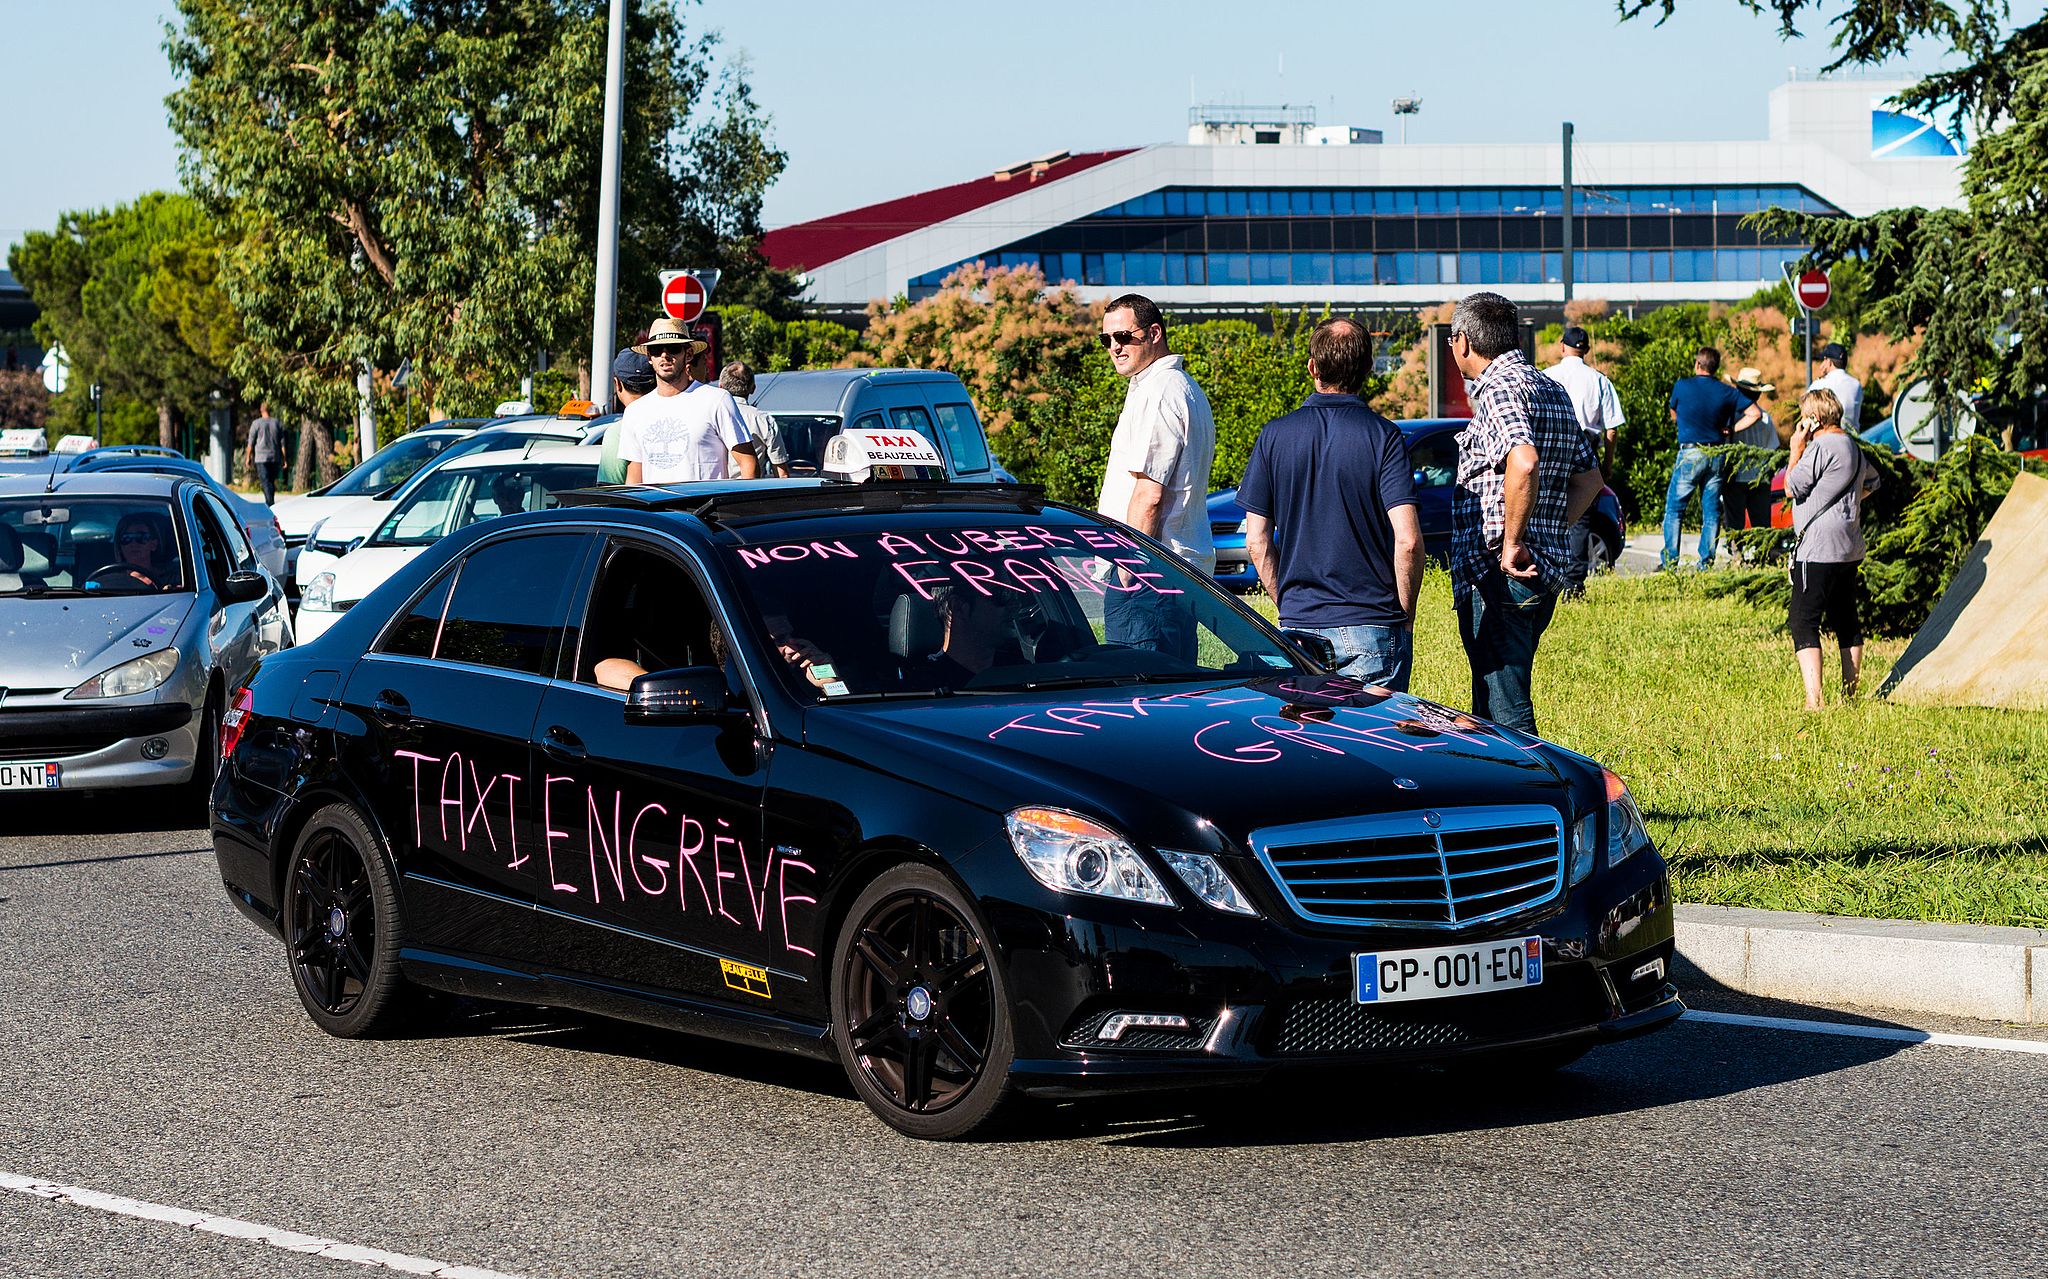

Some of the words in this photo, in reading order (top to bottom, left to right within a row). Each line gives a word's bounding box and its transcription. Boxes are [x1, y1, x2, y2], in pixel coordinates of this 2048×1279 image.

[865, 435, 918, 448] TAXI
[867, 451, 936, 461] BEAUZELLE
[737, 541, 859, 569] NON
[1073, 529, 1141, 551] EN
[891, 556, 1186, 601] FRANCE
[46, 776, 57, 786] 31
[394, 749, 530, 871] TAXI
[1379, 945, 1524, 994] CP-001-EQ
[1528, 962, 1540, 979] 31
[743, 977, 751, 990] 1
[1364, 983, 1372, 994] F
